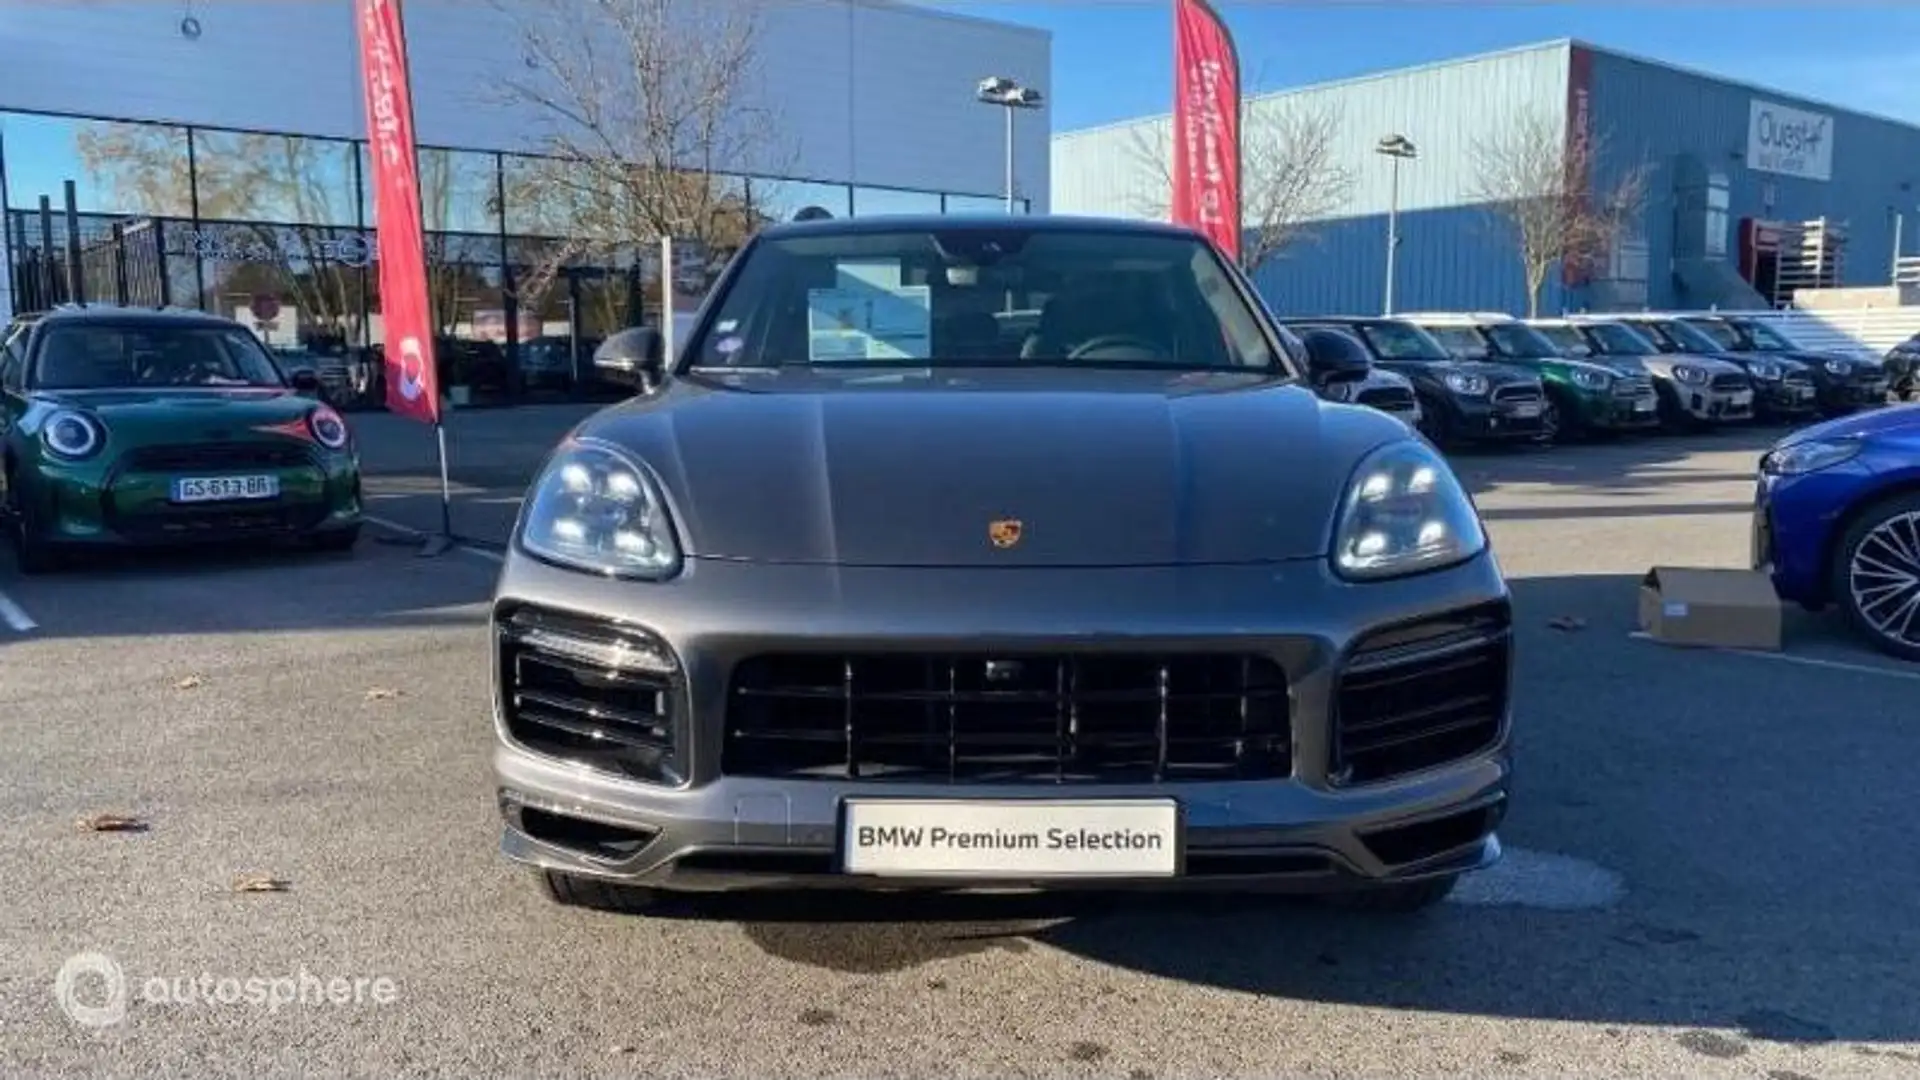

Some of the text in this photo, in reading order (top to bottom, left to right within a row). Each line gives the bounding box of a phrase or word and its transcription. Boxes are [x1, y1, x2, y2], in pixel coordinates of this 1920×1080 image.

[858, 826, 1162, 850] BMW Premium Selection
